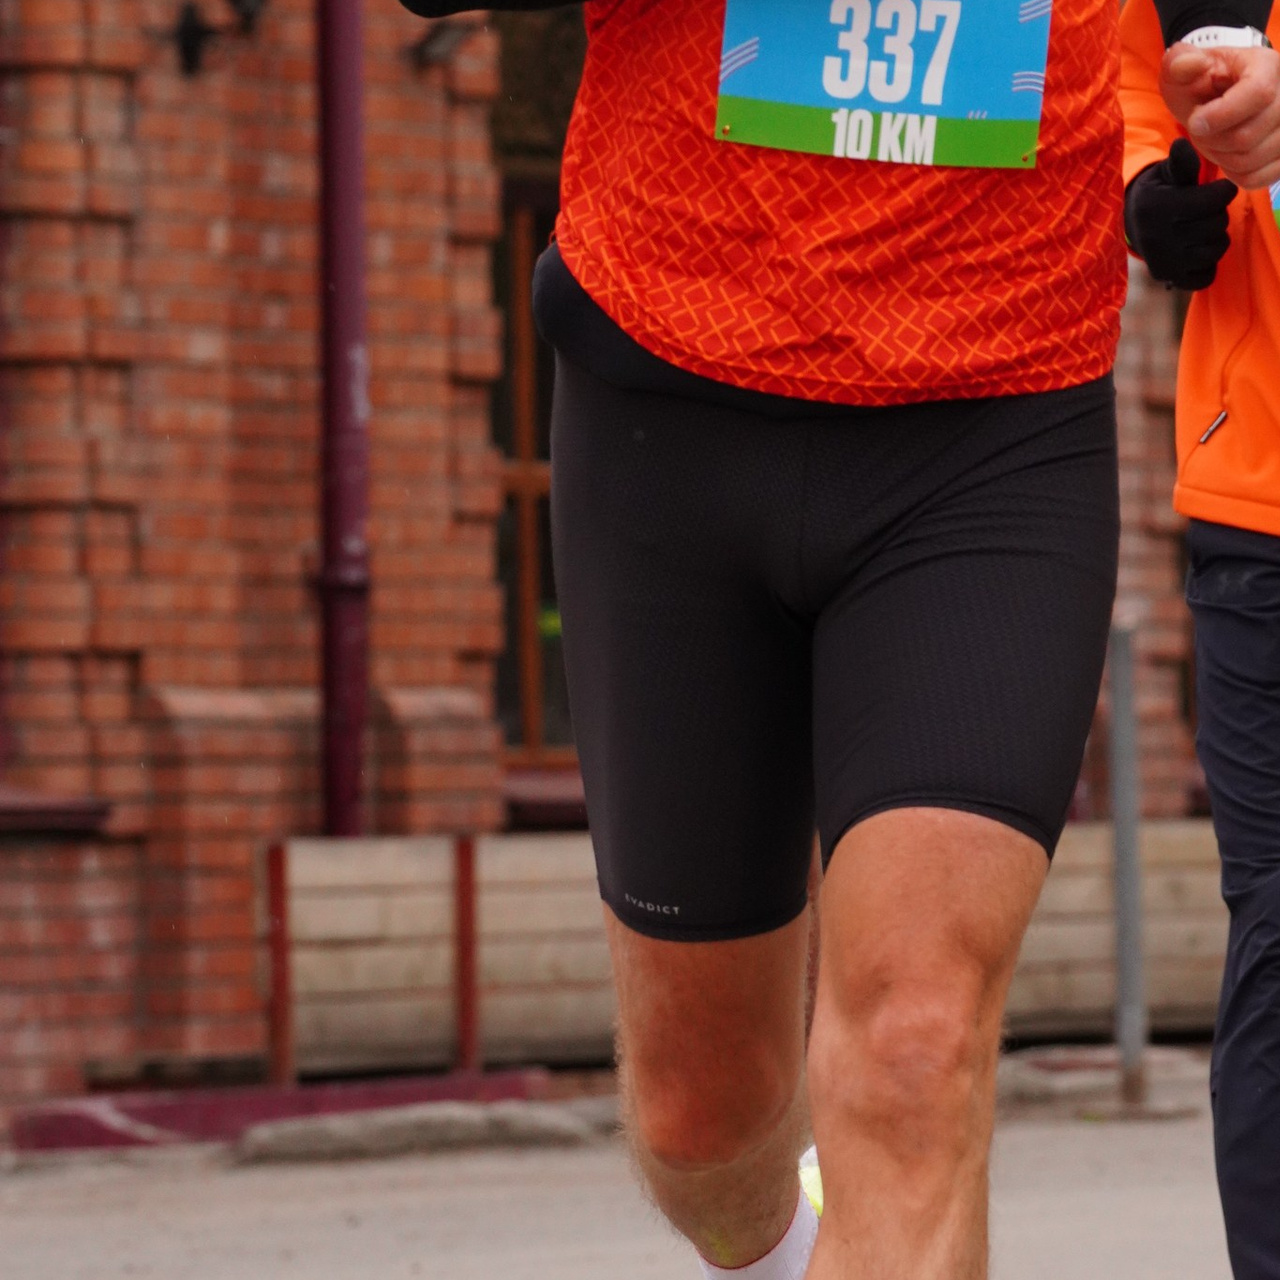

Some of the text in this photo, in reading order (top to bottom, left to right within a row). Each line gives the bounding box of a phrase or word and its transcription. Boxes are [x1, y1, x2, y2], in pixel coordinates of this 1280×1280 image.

[831, 107, 938, 166] 10 KM
[624, 893, 680, 915] EVADICT
